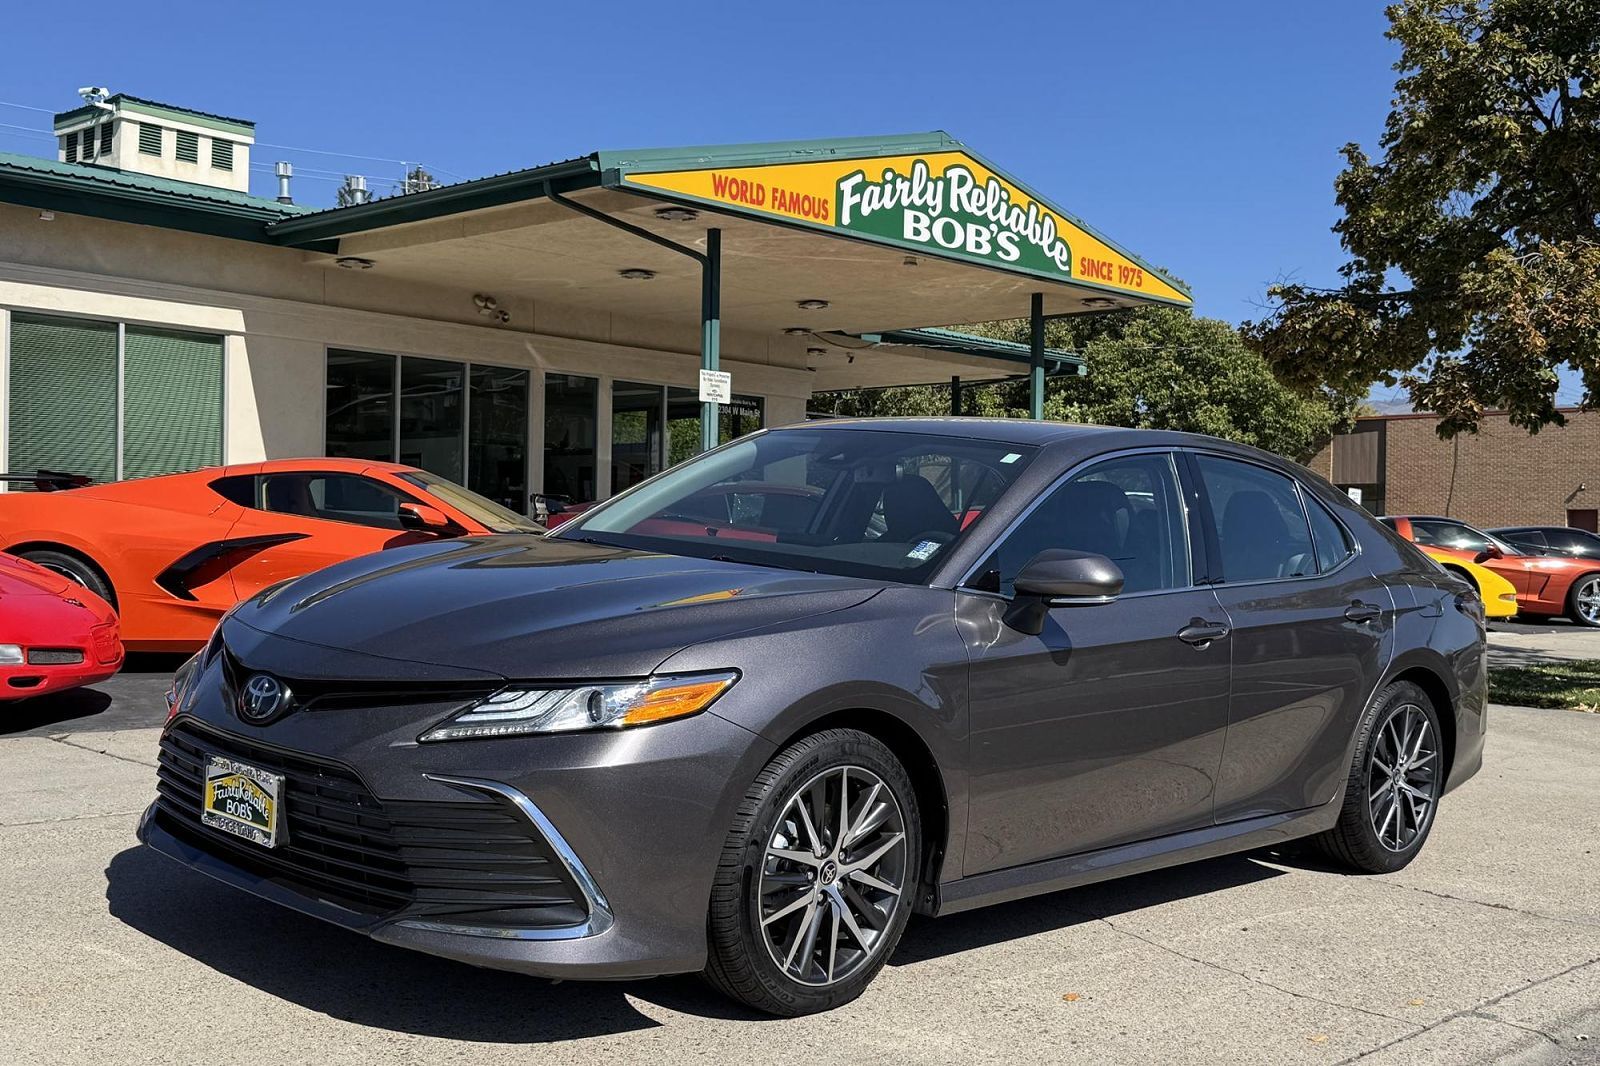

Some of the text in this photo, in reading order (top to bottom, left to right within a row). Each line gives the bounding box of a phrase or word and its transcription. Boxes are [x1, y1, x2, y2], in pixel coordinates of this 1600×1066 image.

[711, 173, 829, 221] WORLD FAMOUS
[840, 162, 1070, 271] Fairly Reliable
[903, 208, 1021, 262] BOB'S
[1080, 256, 1143, 287] SINCE 1975
[732, 406, 739, 415] W
[740, 407, 753, 416] Main
[213, 777, 269, 821] Fairly Reliable
[226, 799, 253, 821] BOB'S
